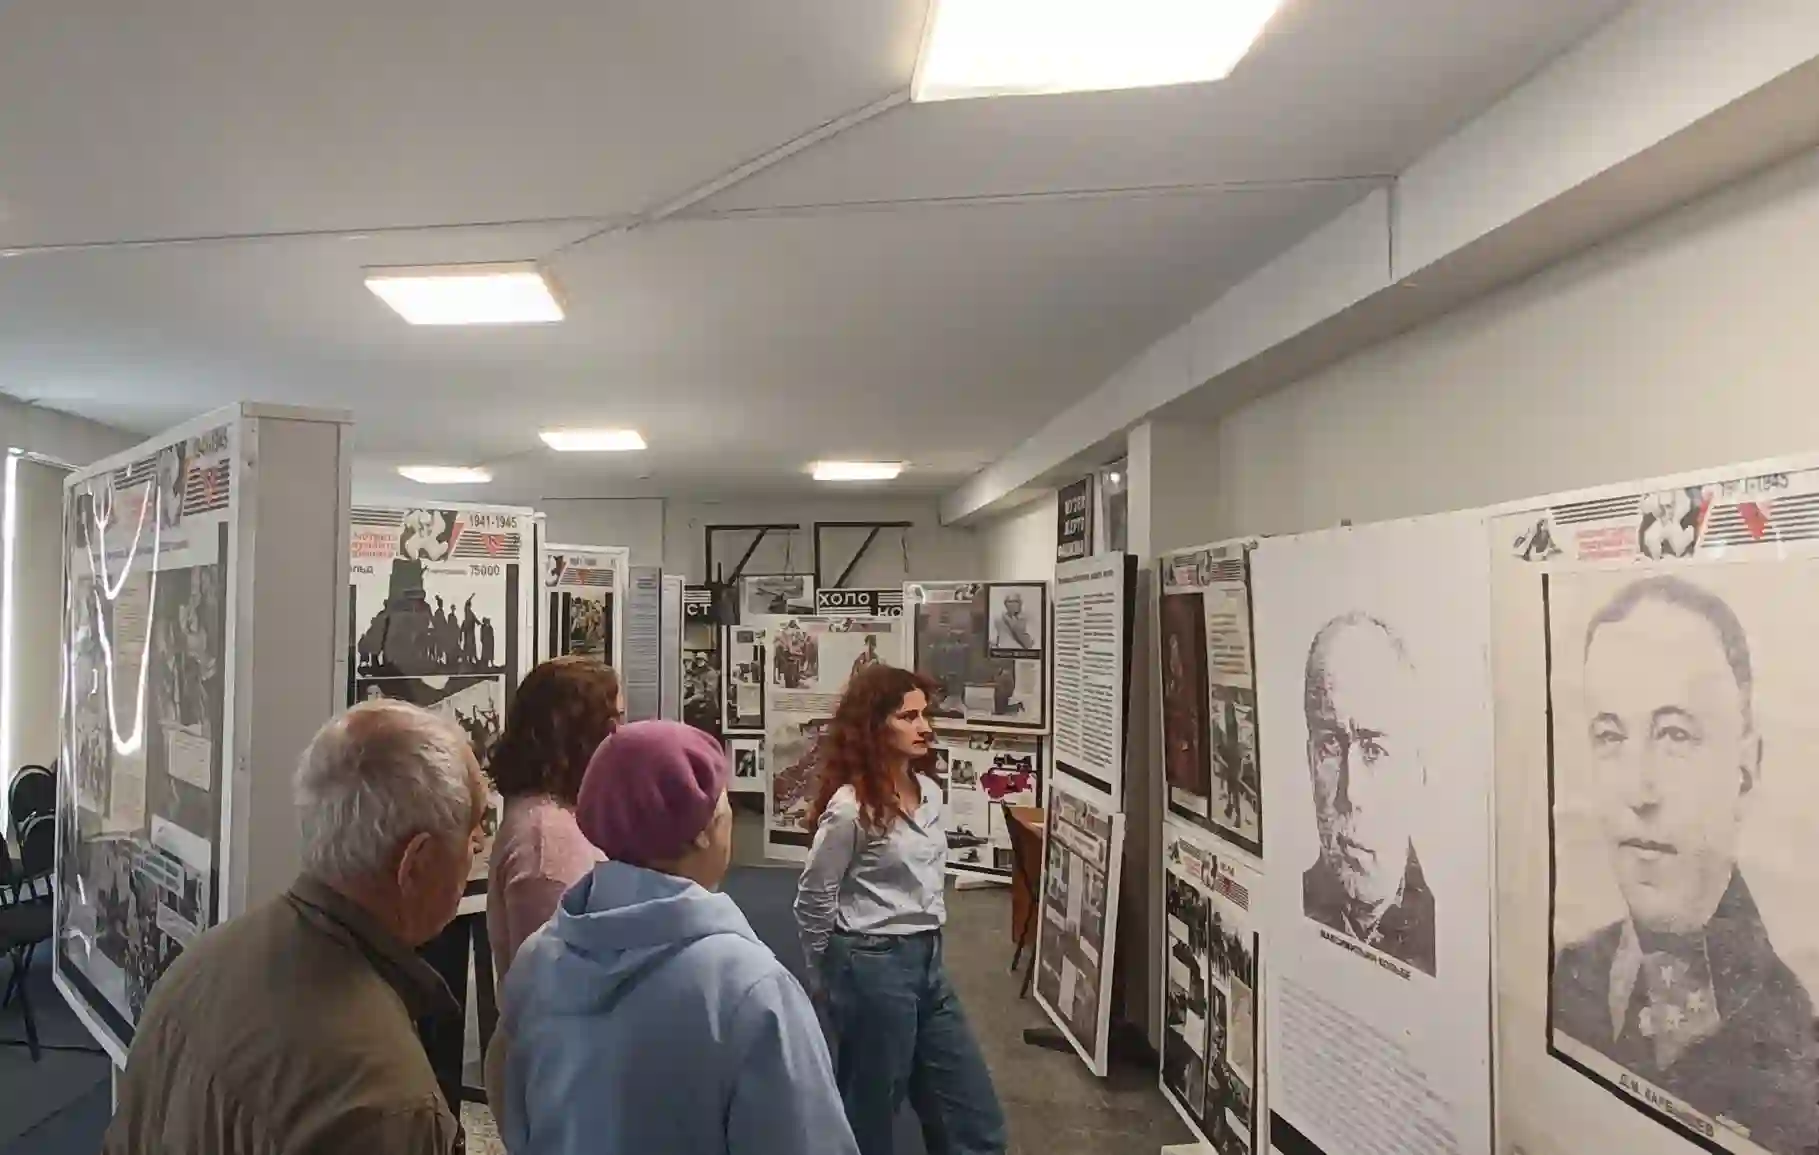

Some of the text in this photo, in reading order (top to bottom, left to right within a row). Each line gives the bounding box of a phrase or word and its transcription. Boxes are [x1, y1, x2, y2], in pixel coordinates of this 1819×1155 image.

[350, 565, 375, 577] льд
[469, 564, 501, 576] 75000
[819, 592, 870, 606] ХОЛО
[686, 603, 712, 616] СТ
